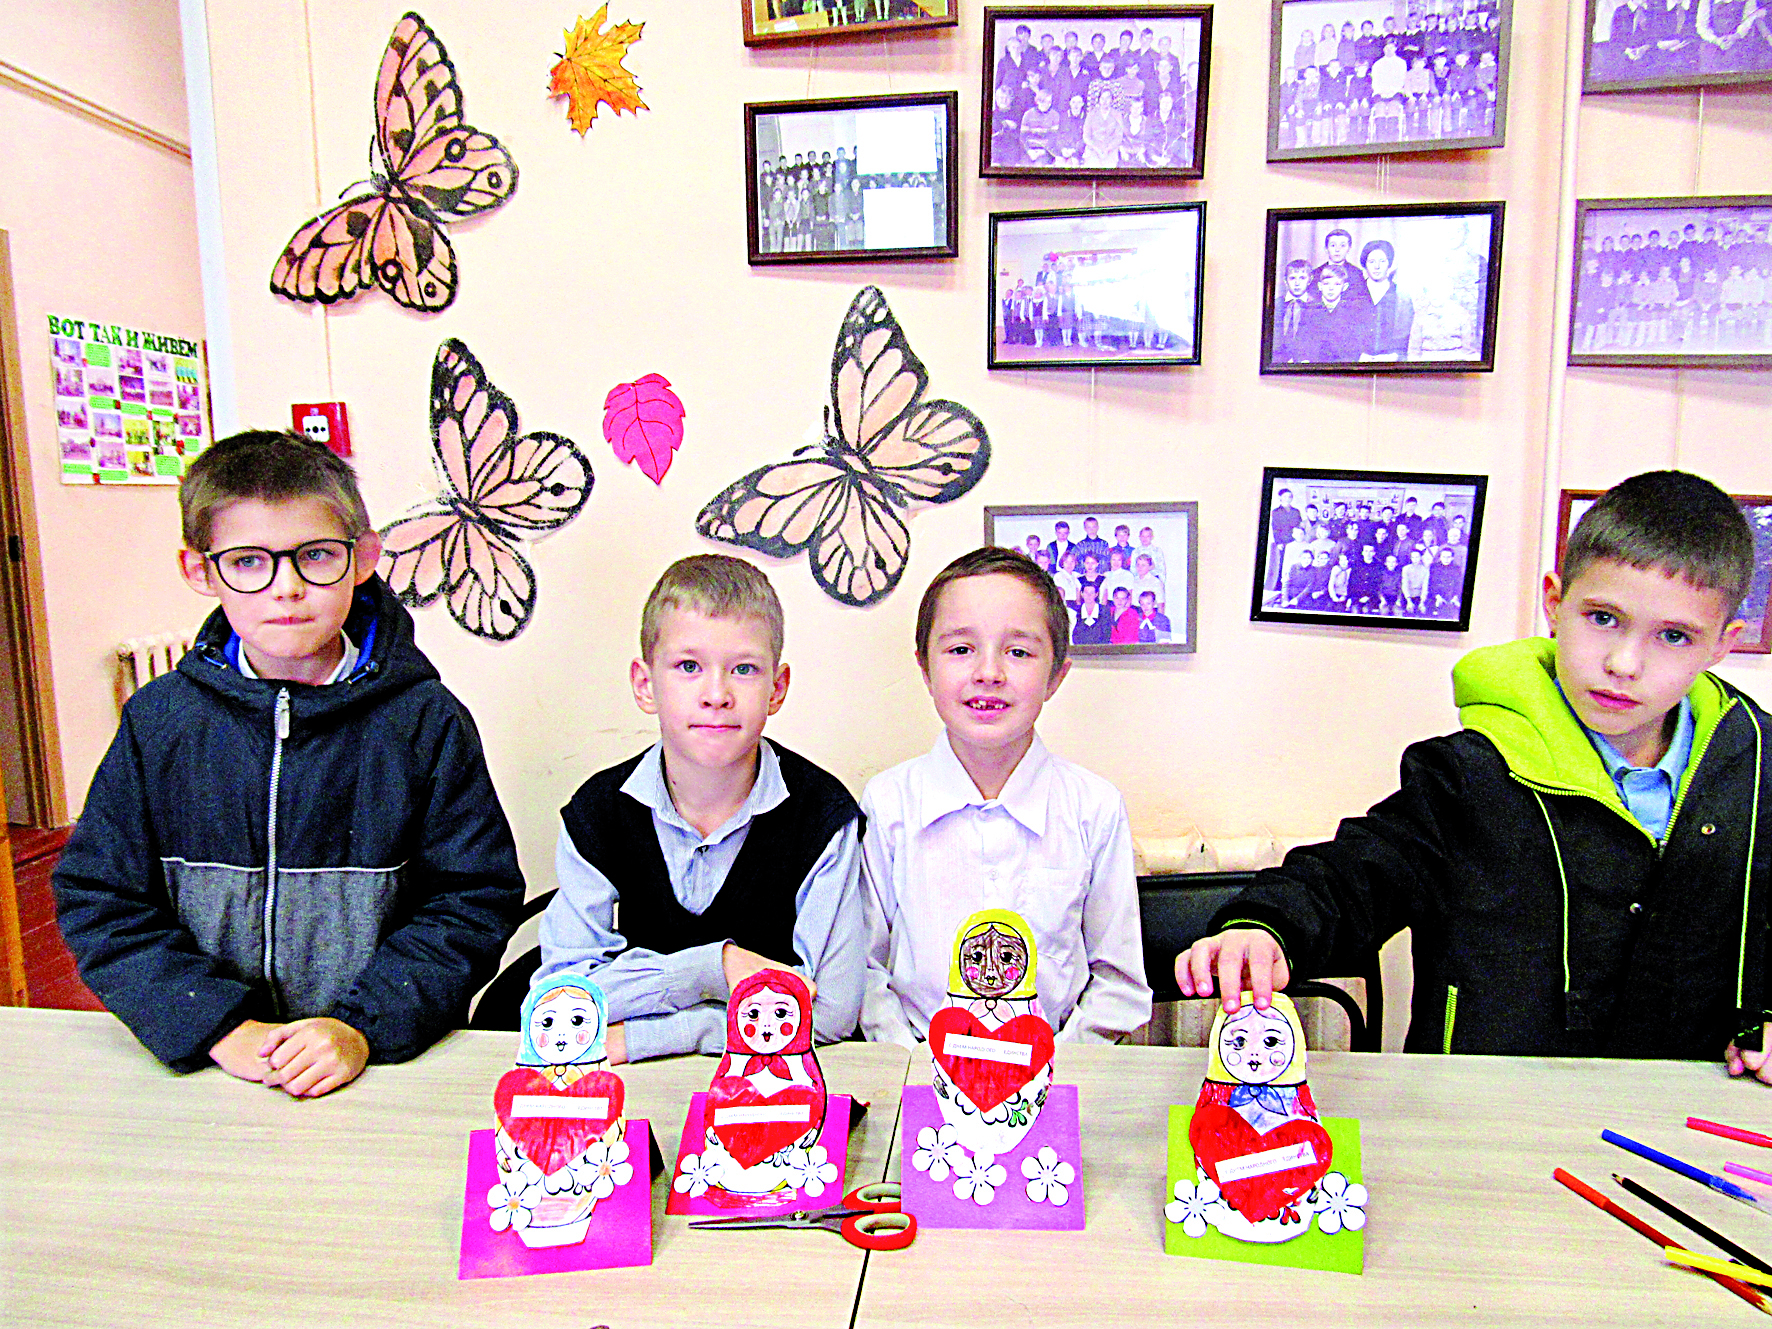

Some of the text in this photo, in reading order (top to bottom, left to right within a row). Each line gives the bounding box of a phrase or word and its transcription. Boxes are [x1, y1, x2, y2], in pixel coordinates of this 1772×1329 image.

[47, 314, 84, 340] ВОТ
[88, 322, 123, 346] ТАК
[125, 328, 139, 348] И
